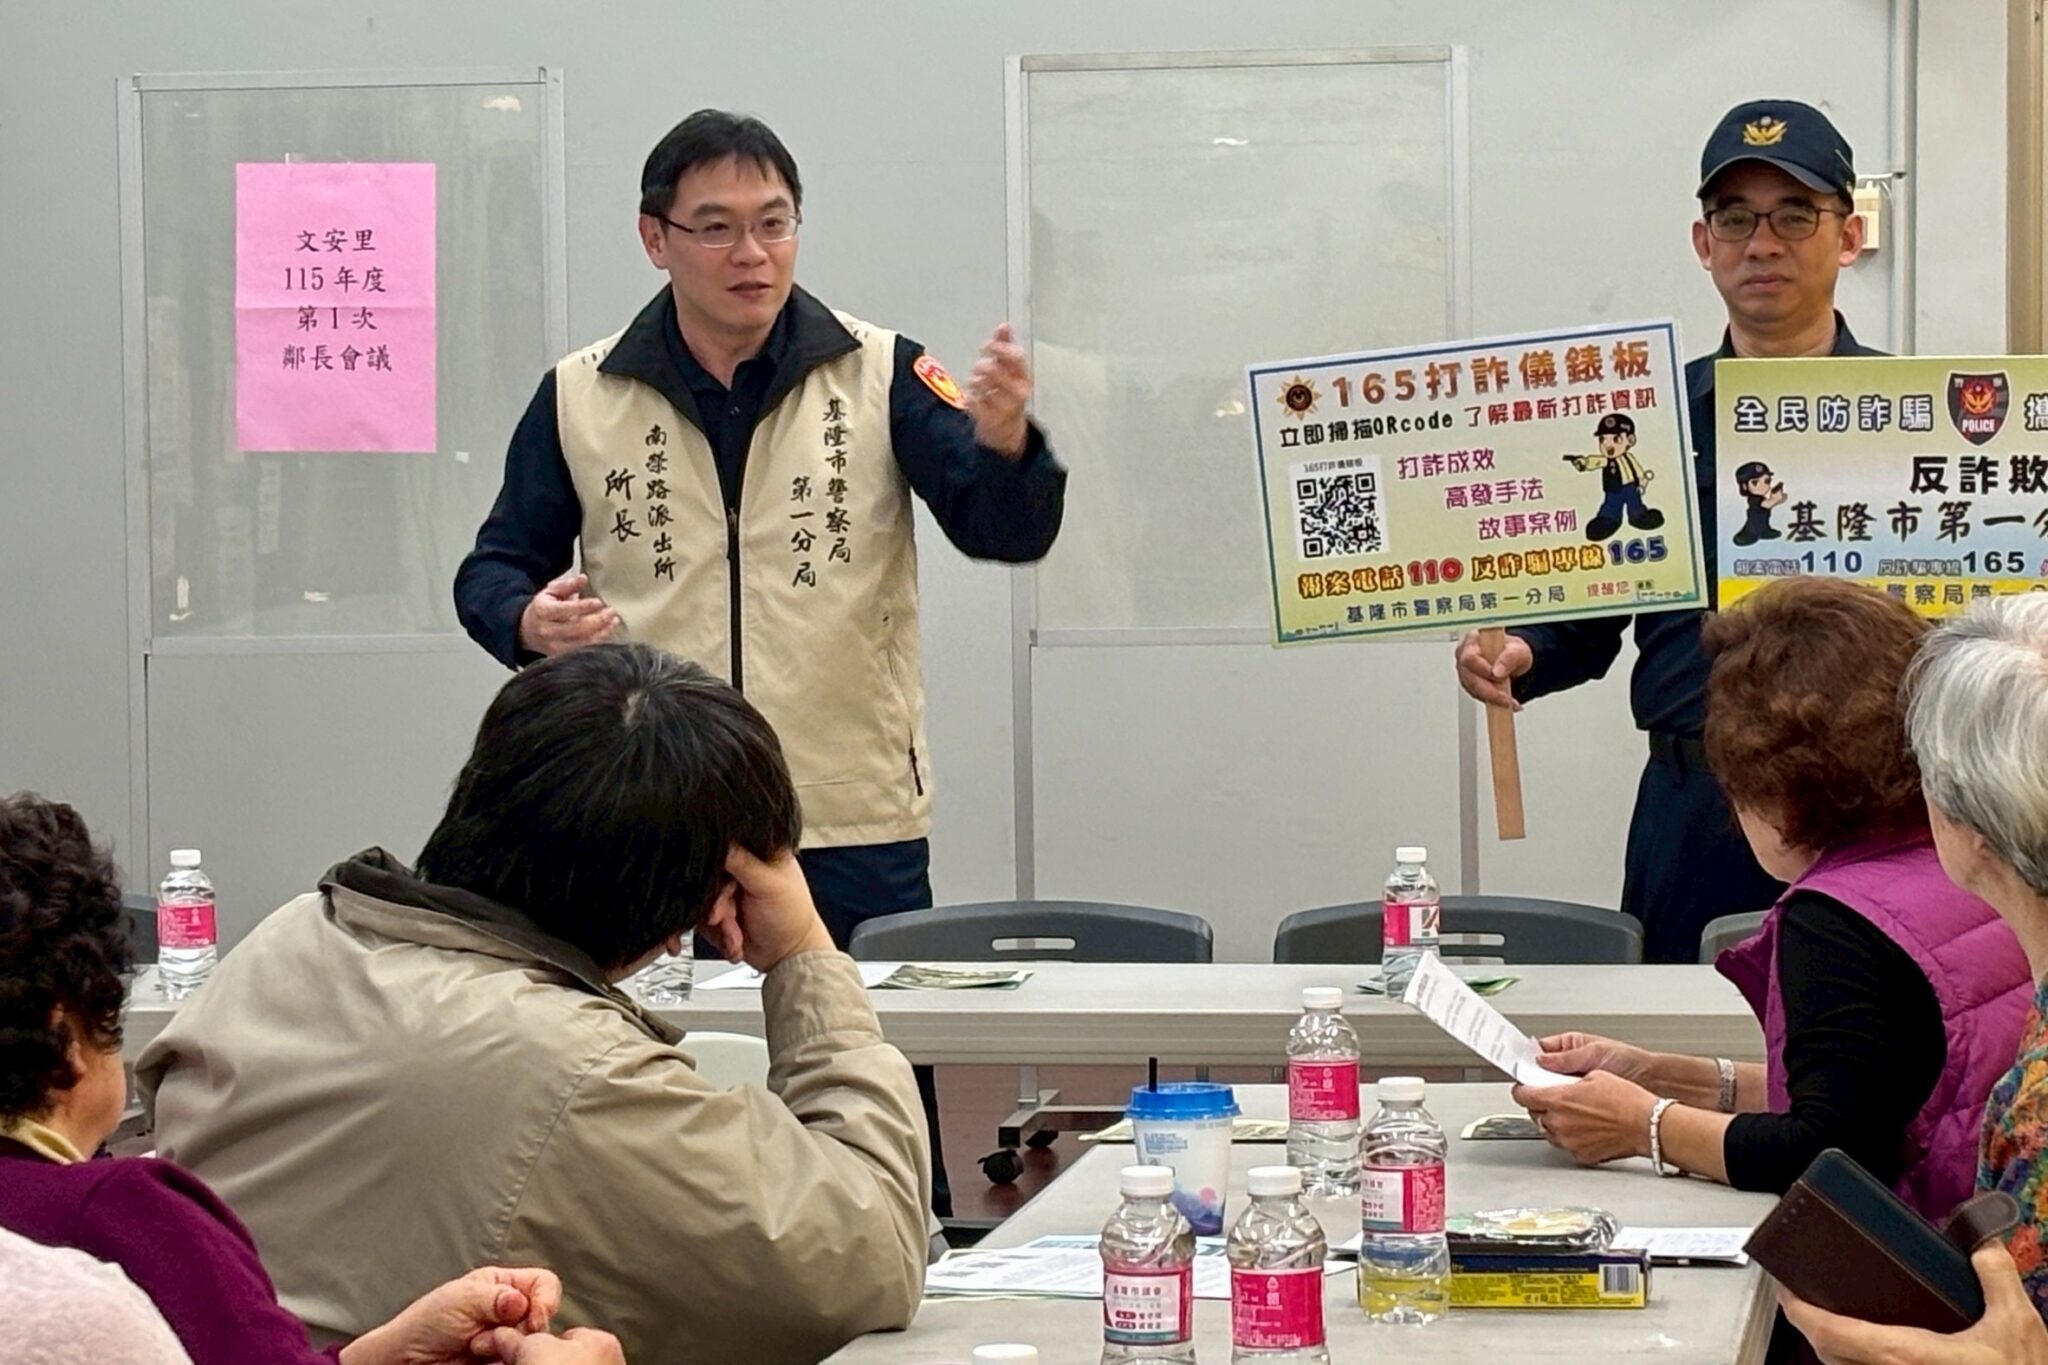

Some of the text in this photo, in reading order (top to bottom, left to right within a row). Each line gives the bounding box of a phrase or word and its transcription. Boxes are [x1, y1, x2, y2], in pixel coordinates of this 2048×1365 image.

[296, 229, 376, 252] 文安里
[282, 344, 392, 372] 鄰長會議
[1332, 340, 1652, 407] 165打詐儀錶板
[1464, 387, 1657, 427] 了解最新打詐資訊
[1734, 395, 1934, 433] 全民防詐騙
[1962, 418, 1995, 433] POLICE
[823, 398, 851, 563] 基隆市警察局
[1397, 447, 1496, 480] 打詐成效
[604, 468, 641, 543] 所長
[645, 424, 677, 583] 南榮路派出所
[1445, 477, 1544, 509] 高發手法
[789, 476, 817, 588] 第一分局
[1478, 509, 1578, 541] 故事案例
[1346, 585, 1565, 625] 基隆市警察局第一分局
